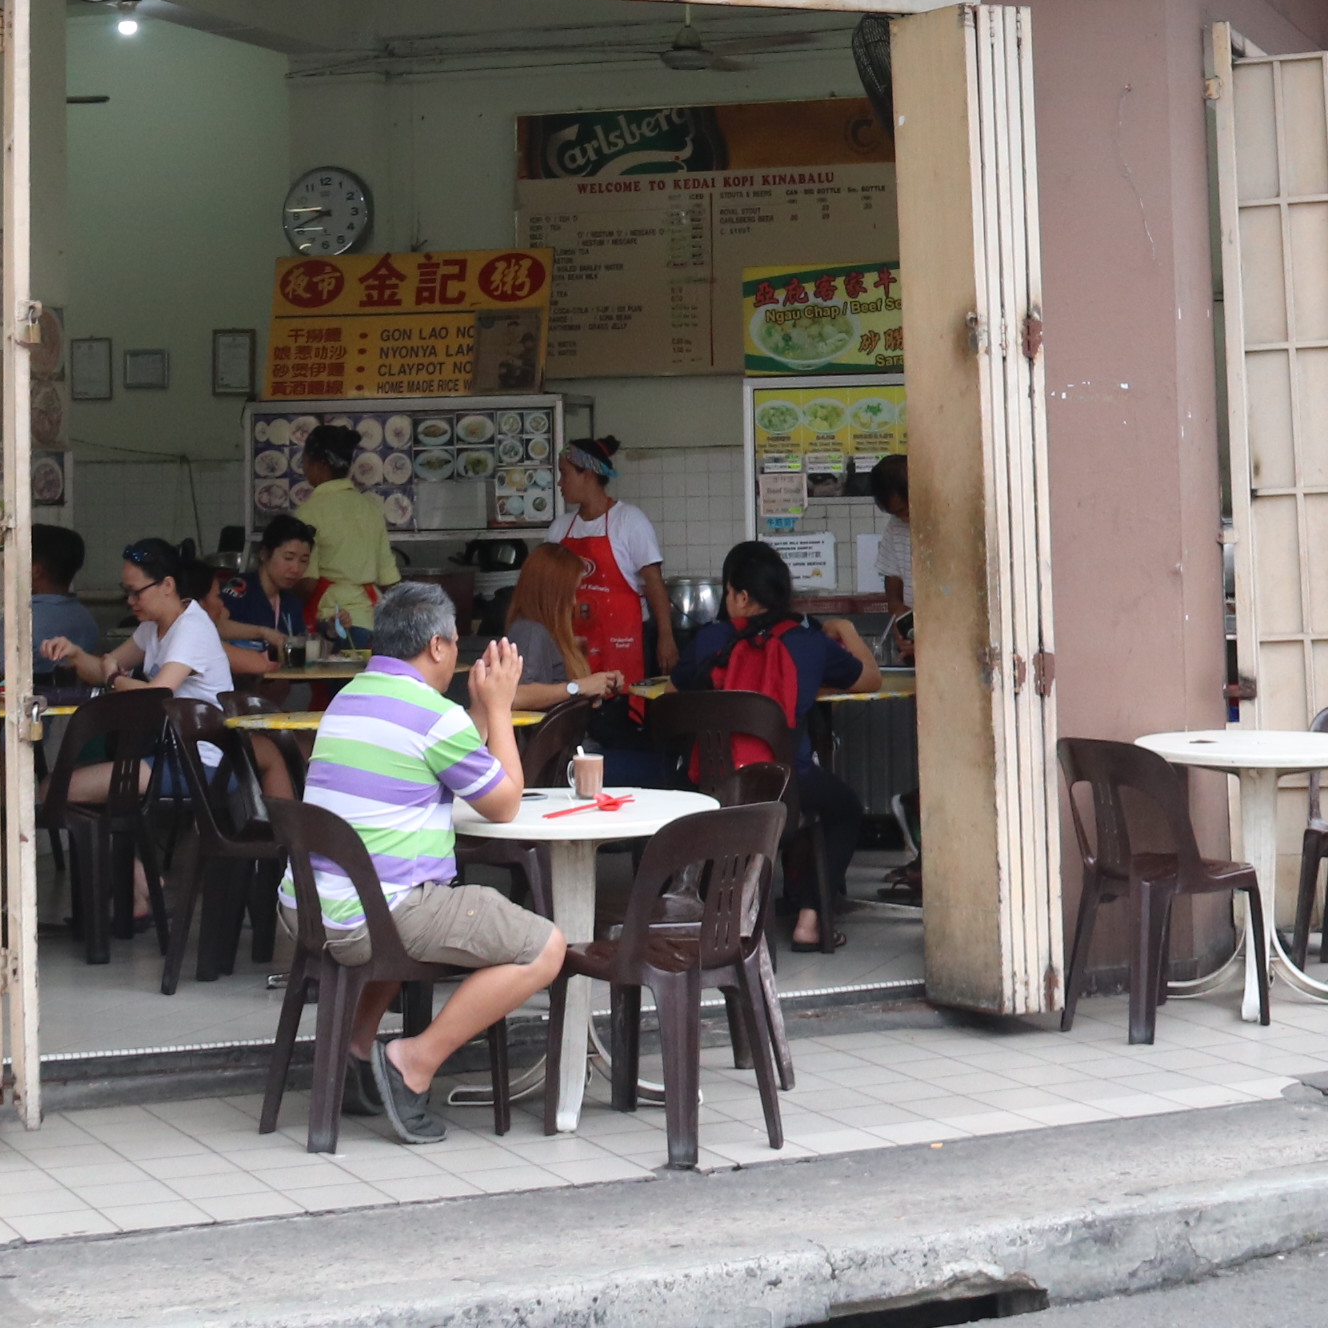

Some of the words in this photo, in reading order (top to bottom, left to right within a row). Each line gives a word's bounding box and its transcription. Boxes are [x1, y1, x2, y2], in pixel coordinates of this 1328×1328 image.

[577, 183, 642, 195] WELCOME
[649, 180, 666, 191] TO
[673, 177, 715, 190] KEDAI
[723, 175, 755, 187] KOPI
[762, 172, 835, 186] KINABALU
[358, 252, 469, 308] 金記
[765, 308, 801, 324] Ngau
[804, 305, 840, 321] Chap
[850, 299, 882, 315] Beef
[380, 328, 412, 342] GON
[419, 327, 449, 341] LAO
[379, 345, 438, 359] NYONYA
[378, 362, 447, 377] CLAYPOT
[377, 380, 404, 394] HOME
[407, 379, 434, 393] MADE
[437, 379, 459, 392] RICE
